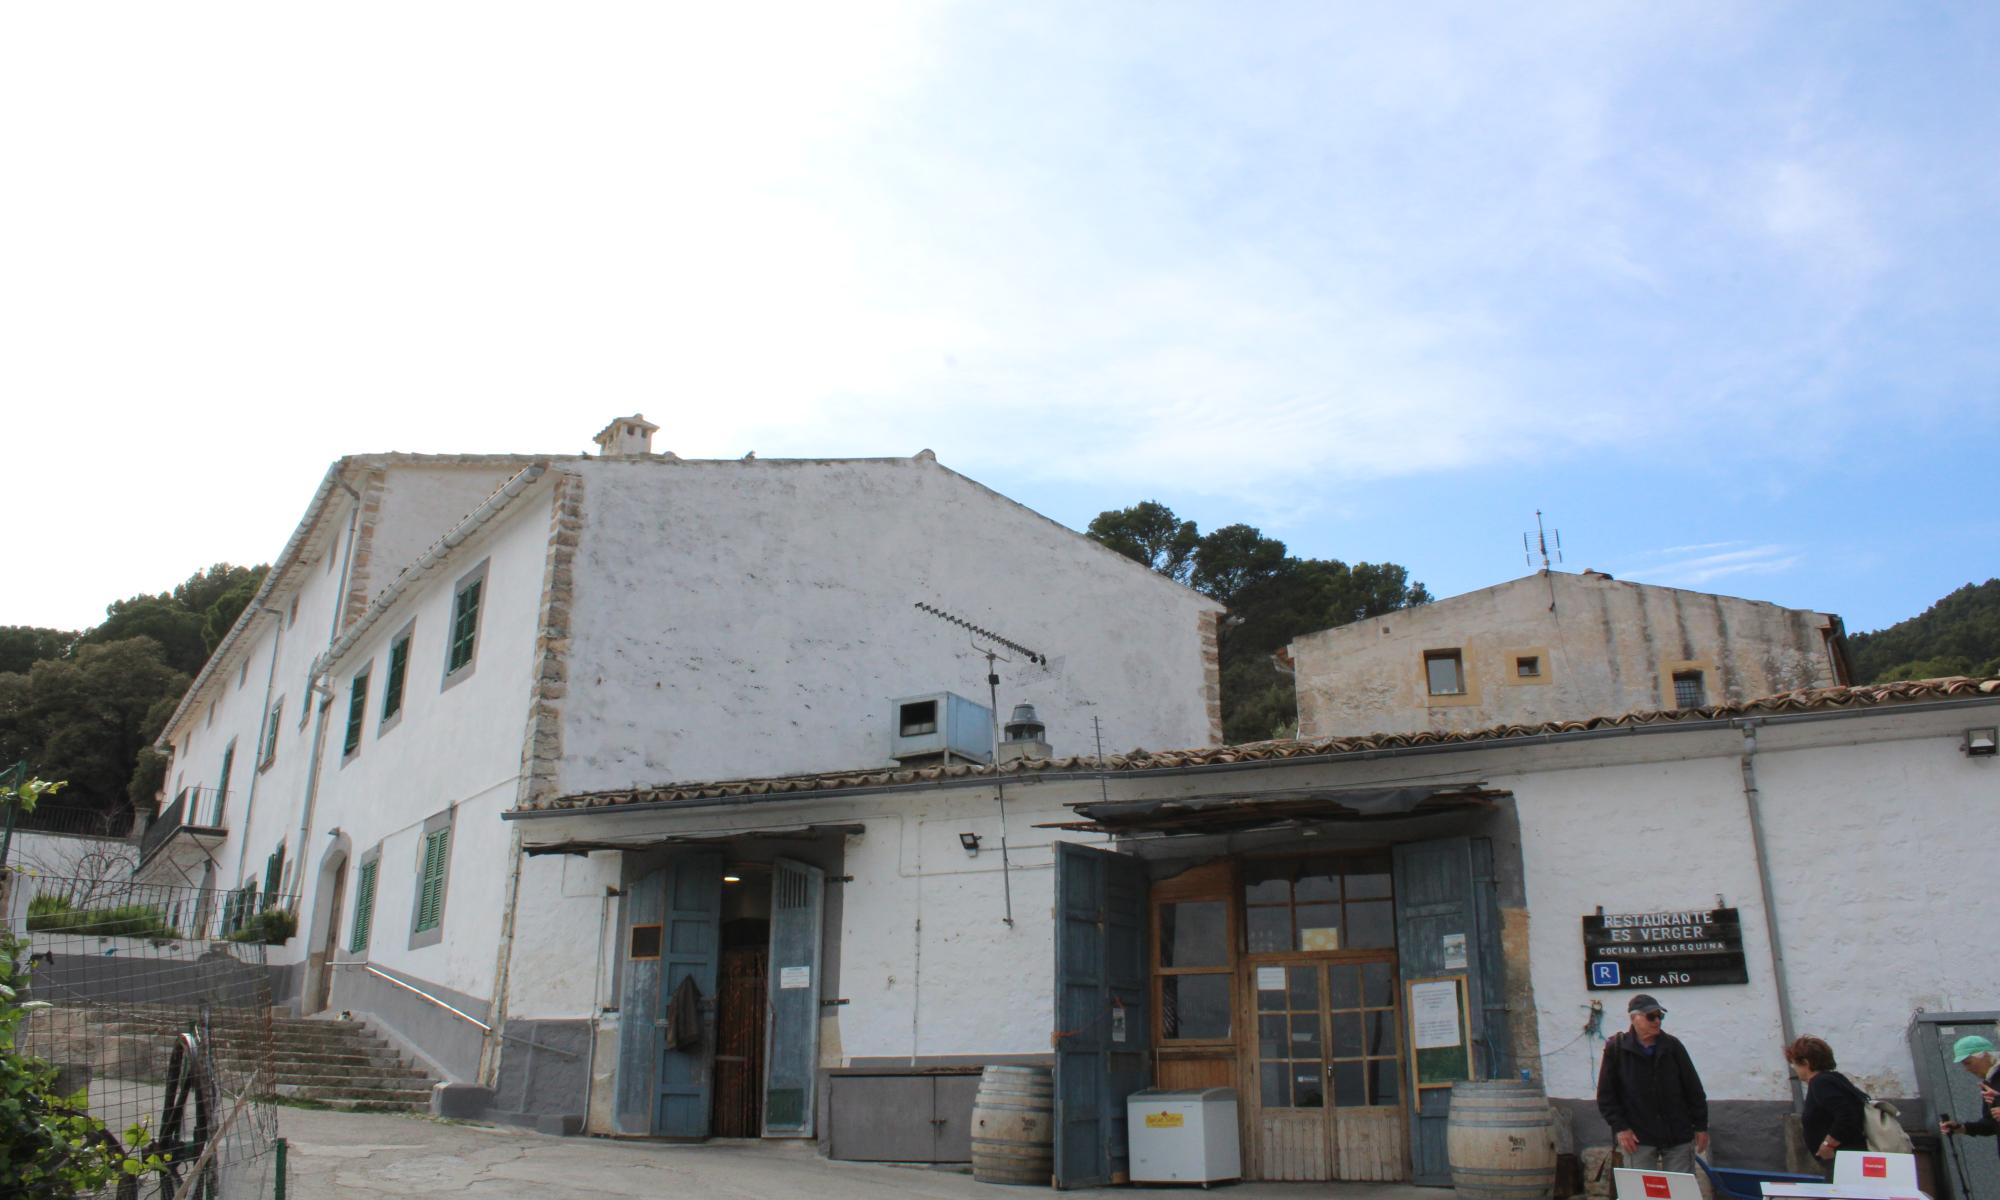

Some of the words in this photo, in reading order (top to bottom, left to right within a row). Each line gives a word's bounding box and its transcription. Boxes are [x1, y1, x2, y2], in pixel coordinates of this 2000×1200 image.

[1604, 911, 1713, 928] RESTAURANTE
[1611, 929, 1631, 942] ES
[1641, 926, 1703, 940] VERGER
[1599, 947, 1637, 955] COCINA
[1643, 942, 1724, 953] MALLORQUINA
[1600, 966, 1611, 979] R
[1630, 975, 1652, 985] DEL
[1659, 971, 1691, 985] AÑO
